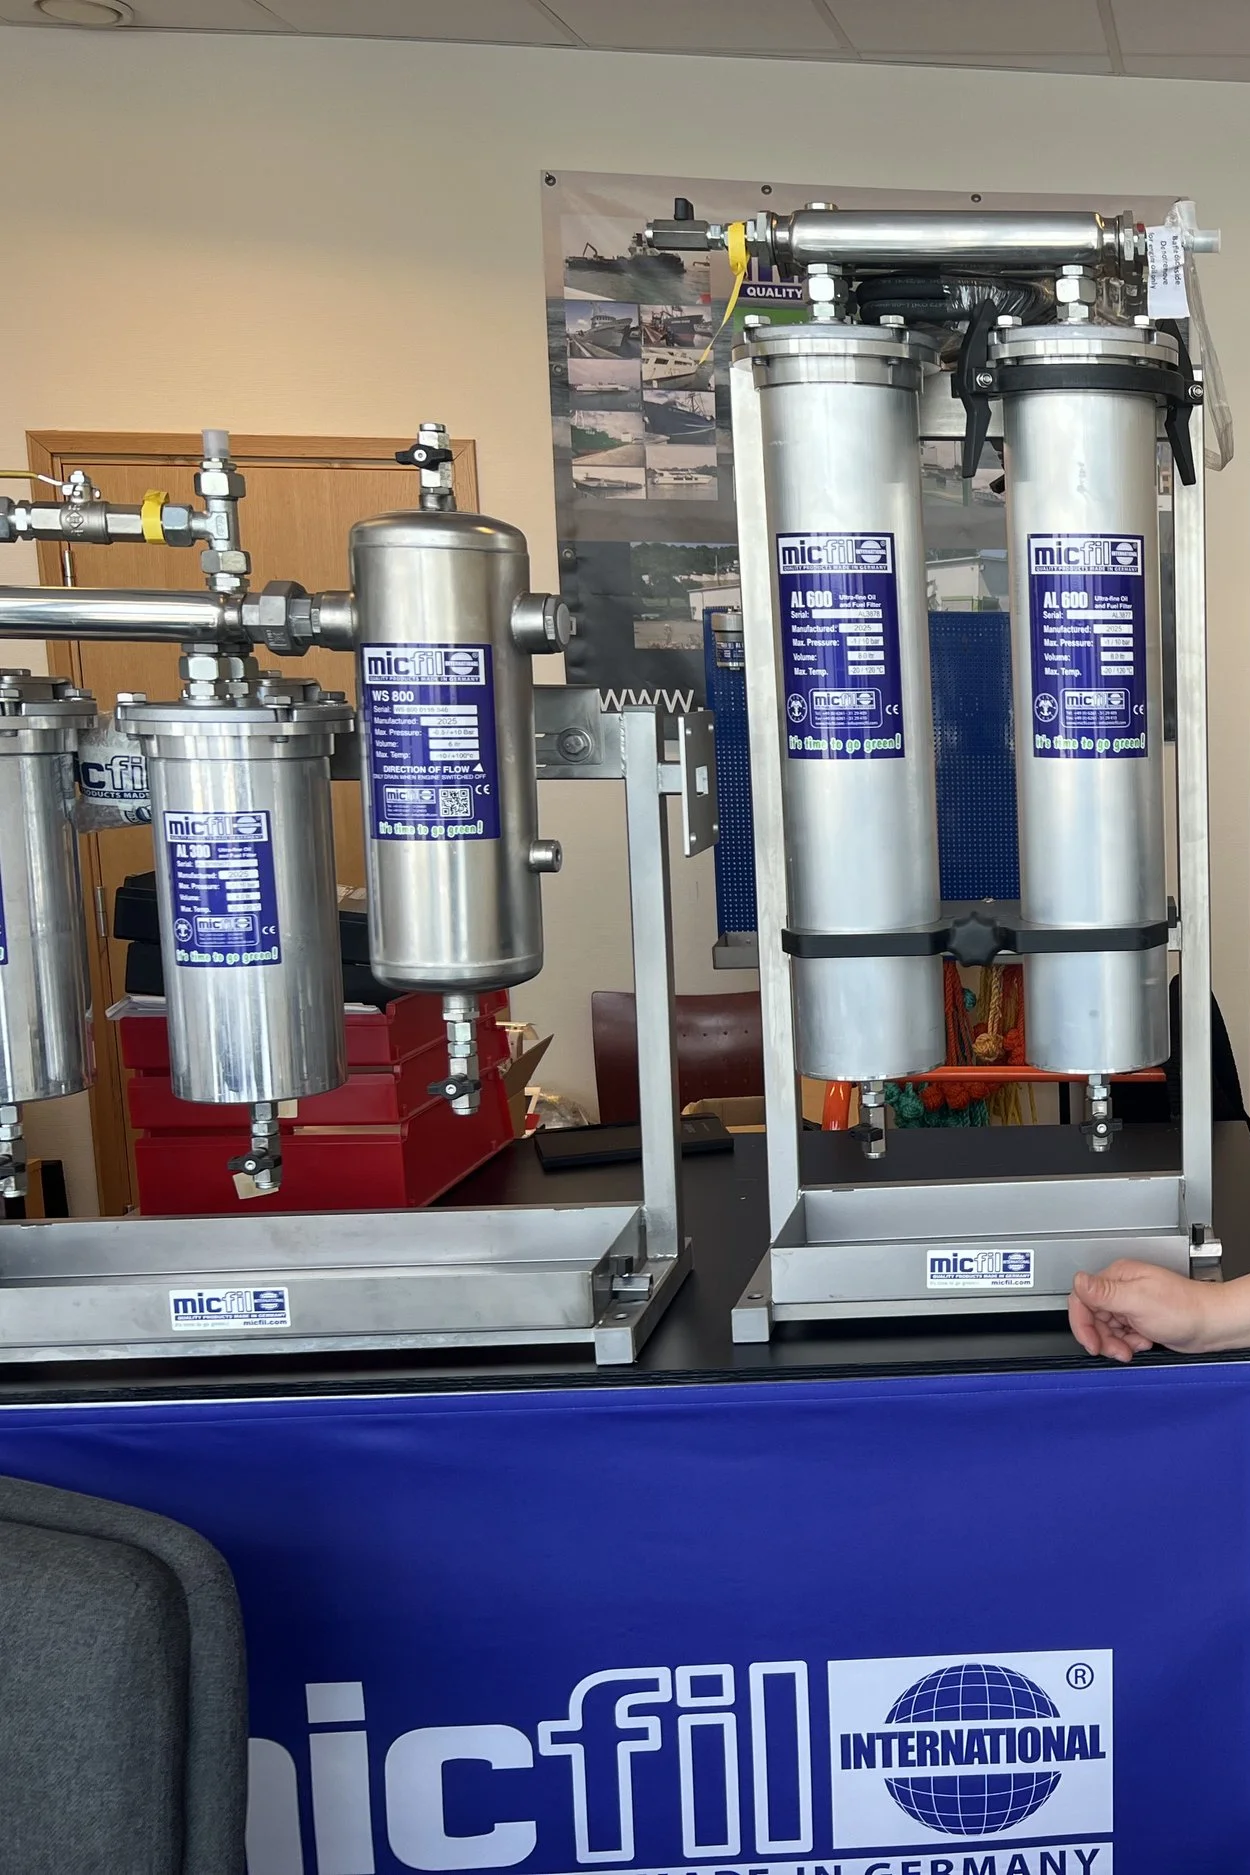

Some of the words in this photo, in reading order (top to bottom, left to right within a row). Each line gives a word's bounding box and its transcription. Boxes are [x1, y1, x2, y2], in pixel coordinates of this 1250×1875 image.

[747, 286, 802, 298] QUALITY
[782, 539, 854, 564] micfil
[1035, 541, 1110, 565] micfil
[791, 591, 805, 608] AL
[806, 591, 833, 608] 600
[1043, 591, 1059, 608] AL
[1061, 591, 1088, 609] 600
[791, 610, 809, 619] Serial:
[1043, 611, 1063, 619] Serial:
[792, 624, 838, 632] Manufactured:
[1043, 625, 1091, 633] Manufactured:
[807, 639, 840, 647] Pressure:
[1044, 639, 1059, 647] Max.
[1060, 639, 1094, 647] Pressure:
[368, 651, 443, 675] micfil
[793, 653, 817, 661] Volume:
[1044, 653, 1071, 661] Volume:
[808, 668, 828, 677] Temp.
[1061, 668, 1082, 677] Temp.
[372, 690, 390, 702] WS
[391, 690, 414, 702] 800
[374, 717, 419, 725] Manufactured:
[375, 728, 388, 736] Max.
[389, 728, 422, 736] Pressure:
[804, 736, 828, 750] time
[830, 737, 843, 750] to
[846, 739, 861, 753] go
[1054, 735, 1078, 750] time
[1081, 737, 1094, 750] to
[1096, 738, 1111, 753] go
[383, 765, 426, 773] DIRECTION
[428, 765, 441, 773] OF
[443, 765, 470, 773] FLOW
[169, 816, 232, 835] micfil
[176, 844, 188, 858] AL
[189, 844, 211, 858] 300
[930, 1252, 1001, 1273] micfil
[173, 1291, 252, 1314] micfil
[840, 1724, 1107, 1771] INTERNATIONAL
